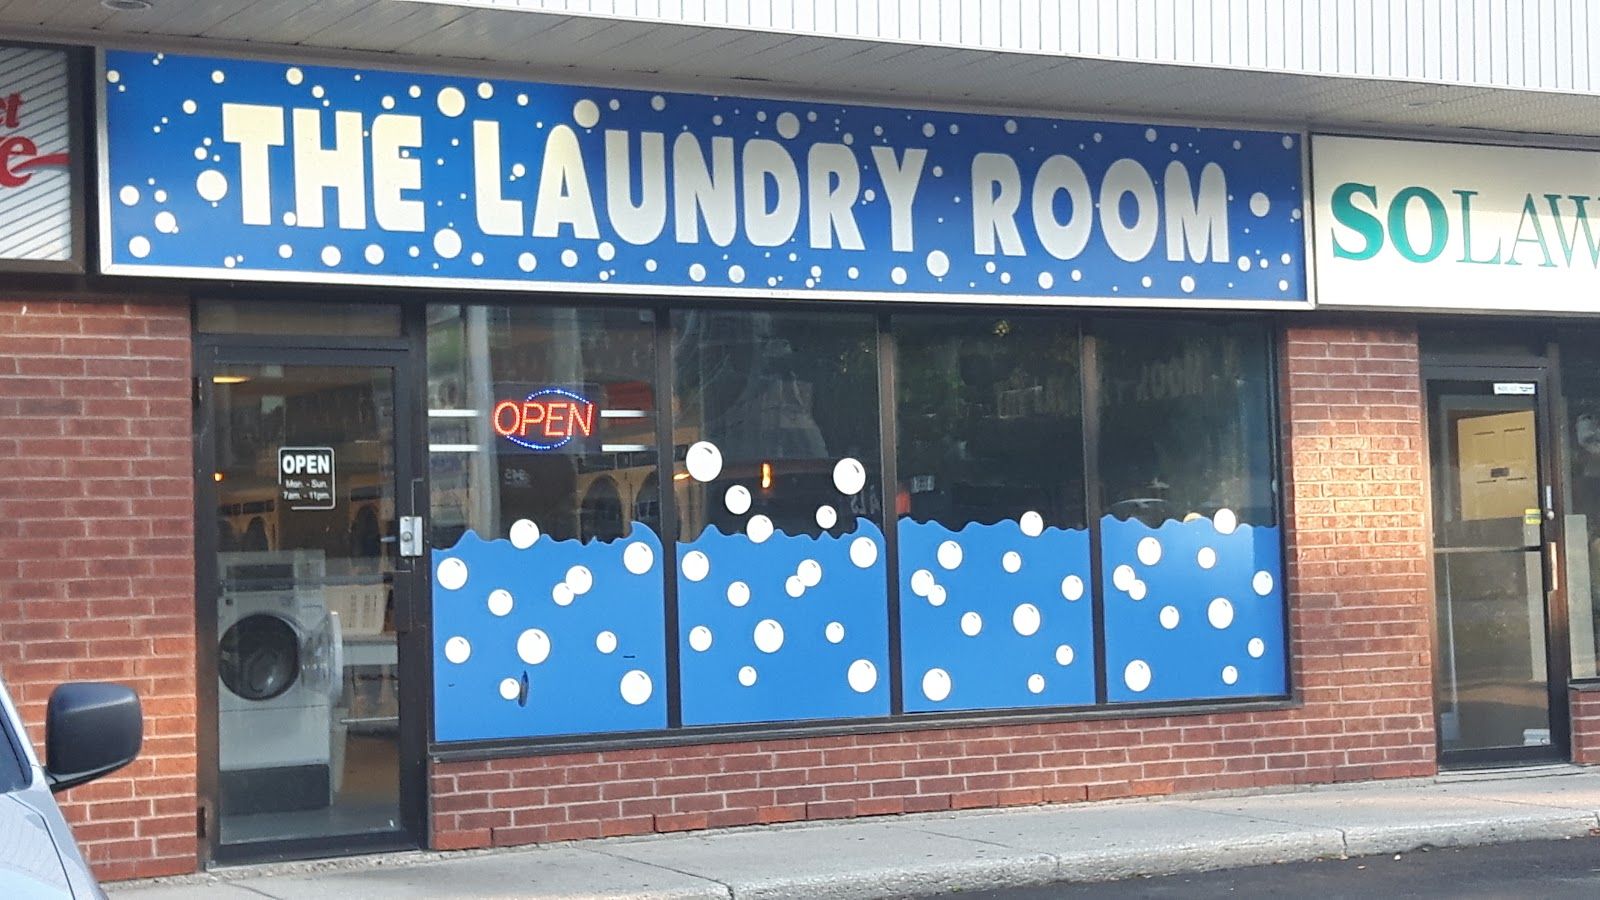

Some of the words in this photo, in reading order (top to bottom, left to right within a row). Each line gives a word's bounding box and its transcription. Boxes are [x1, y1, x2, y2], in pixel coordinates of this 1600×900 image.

[222, 103, 426, 233] THE
[472, 119, 929, 253] LAUNDRY
[971, 152, 1230, 264] ROOM
[493, 400, 594, 437] OPEN
[282, 454, 330, 474] OPEN
